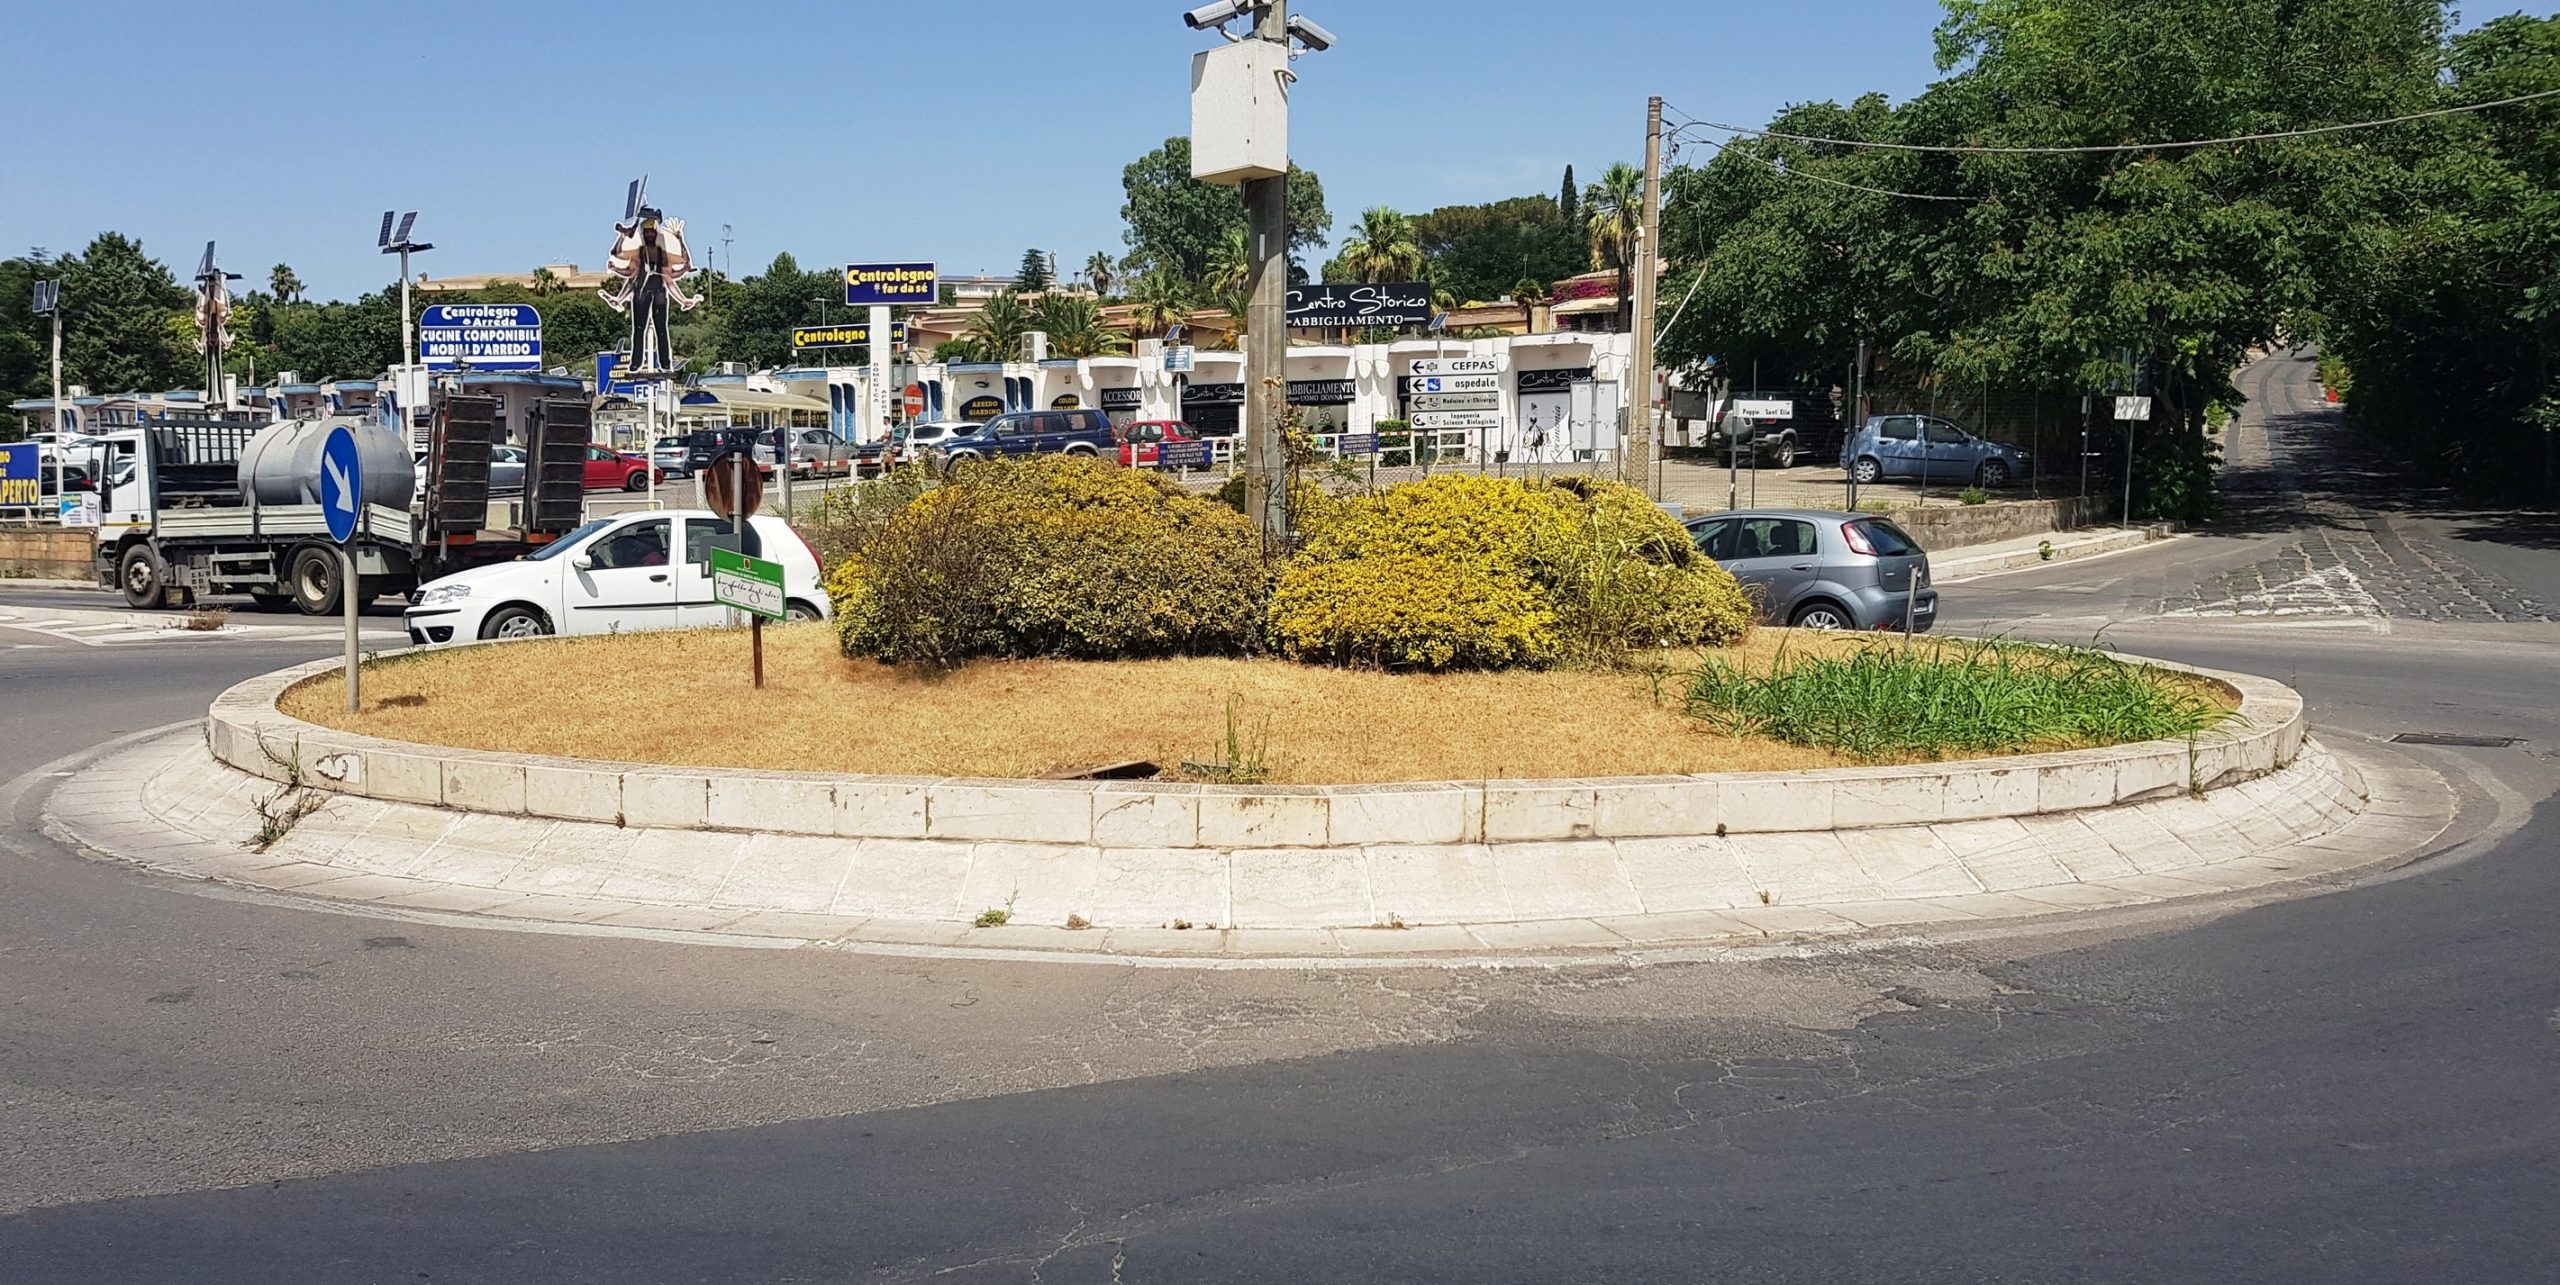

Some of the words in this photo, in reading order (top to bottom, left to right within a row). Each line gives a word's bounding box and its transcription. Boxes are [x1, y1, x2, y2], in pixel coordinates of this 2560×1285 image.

[847, 268, 934, 285] Centrolegno
[882, 283, 899, 294] far
[900, 283, 914, 293] da
[915, 282, 928, 293] sé
[1287, 287, 1346, 313] Centro
[1350, 286, 1427, 315] Storico
[441, 306, 518, 320] Centrolegno
[1293, 315, 1404, 327] ABBIGLIAMENTO
[421, 329, 462, 342] CUCINE
[463, 329, 540, 342] COMPONIBILI
[794, 328, 866, 347] Centrolegno
[893, 328, 903, 338] sé
[429, 343, 470, 356] MOBILI
[472, 342, 531, 356] D'ARREDO
[1451, 361, 1495, 371] CEFPAS
[1455, 377, 1496, 389] ospedale
[1102, 391, 1142, 402] ACCESSOR
[1214, 384, 1244, 400] Storic
